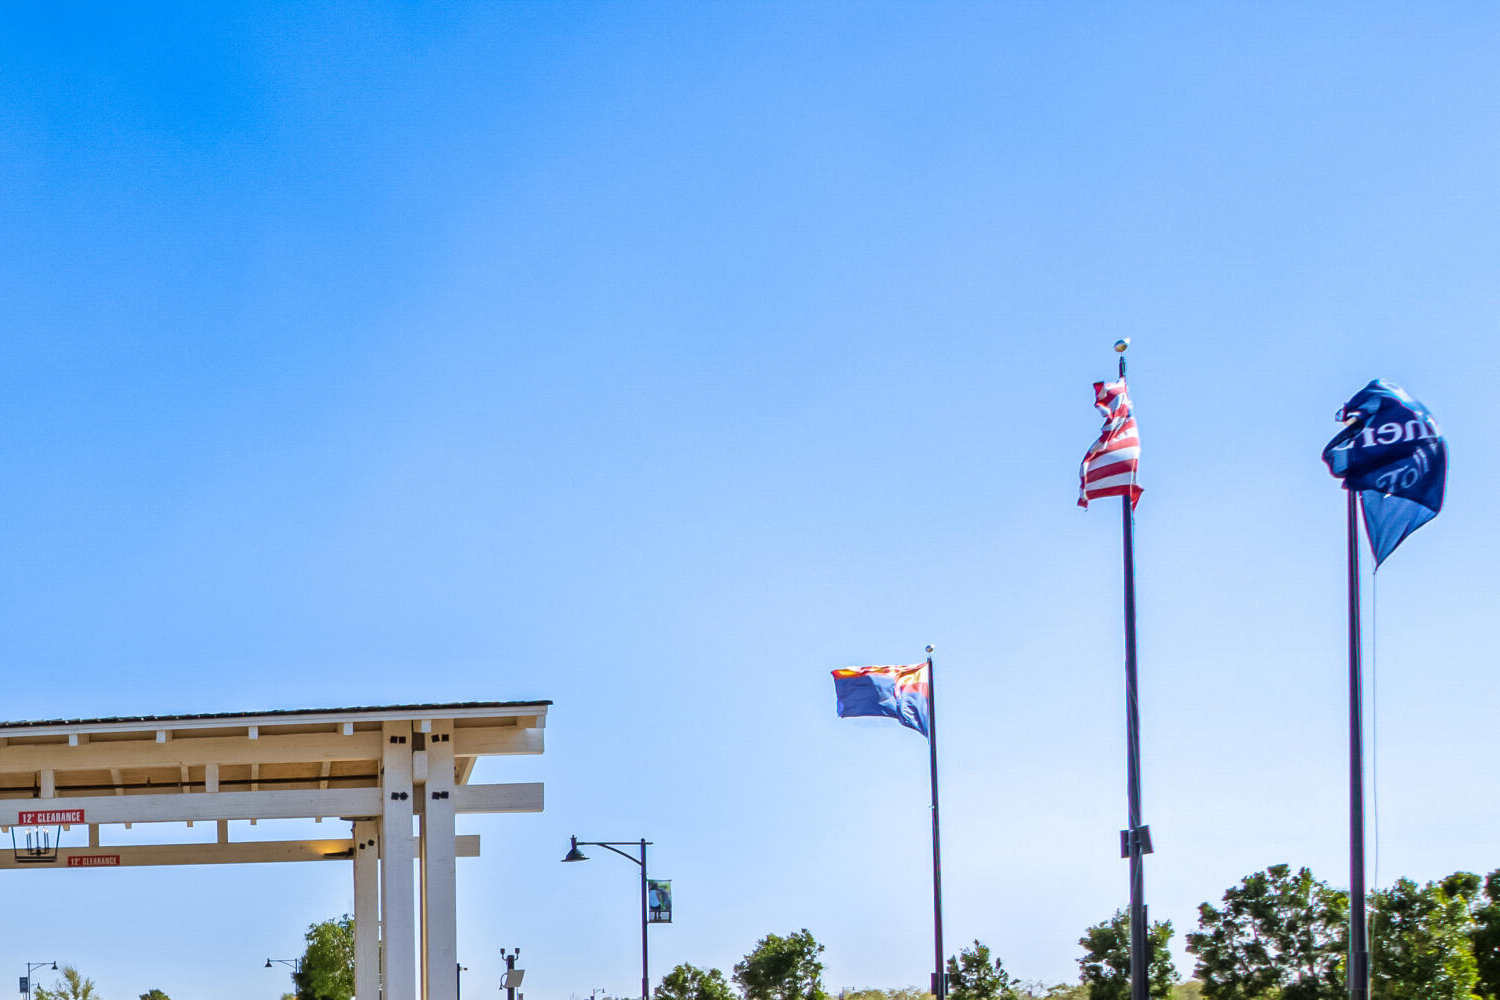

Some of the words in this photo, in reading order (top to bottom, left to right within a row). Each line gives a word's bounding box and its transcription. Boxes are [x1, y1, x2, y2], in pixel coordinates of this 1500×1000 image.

[22, 813, 35, 824] 12'
[37, 811, 81, 823] CLEARANCE
[83, 856, 117, 865] CLEARANCE
